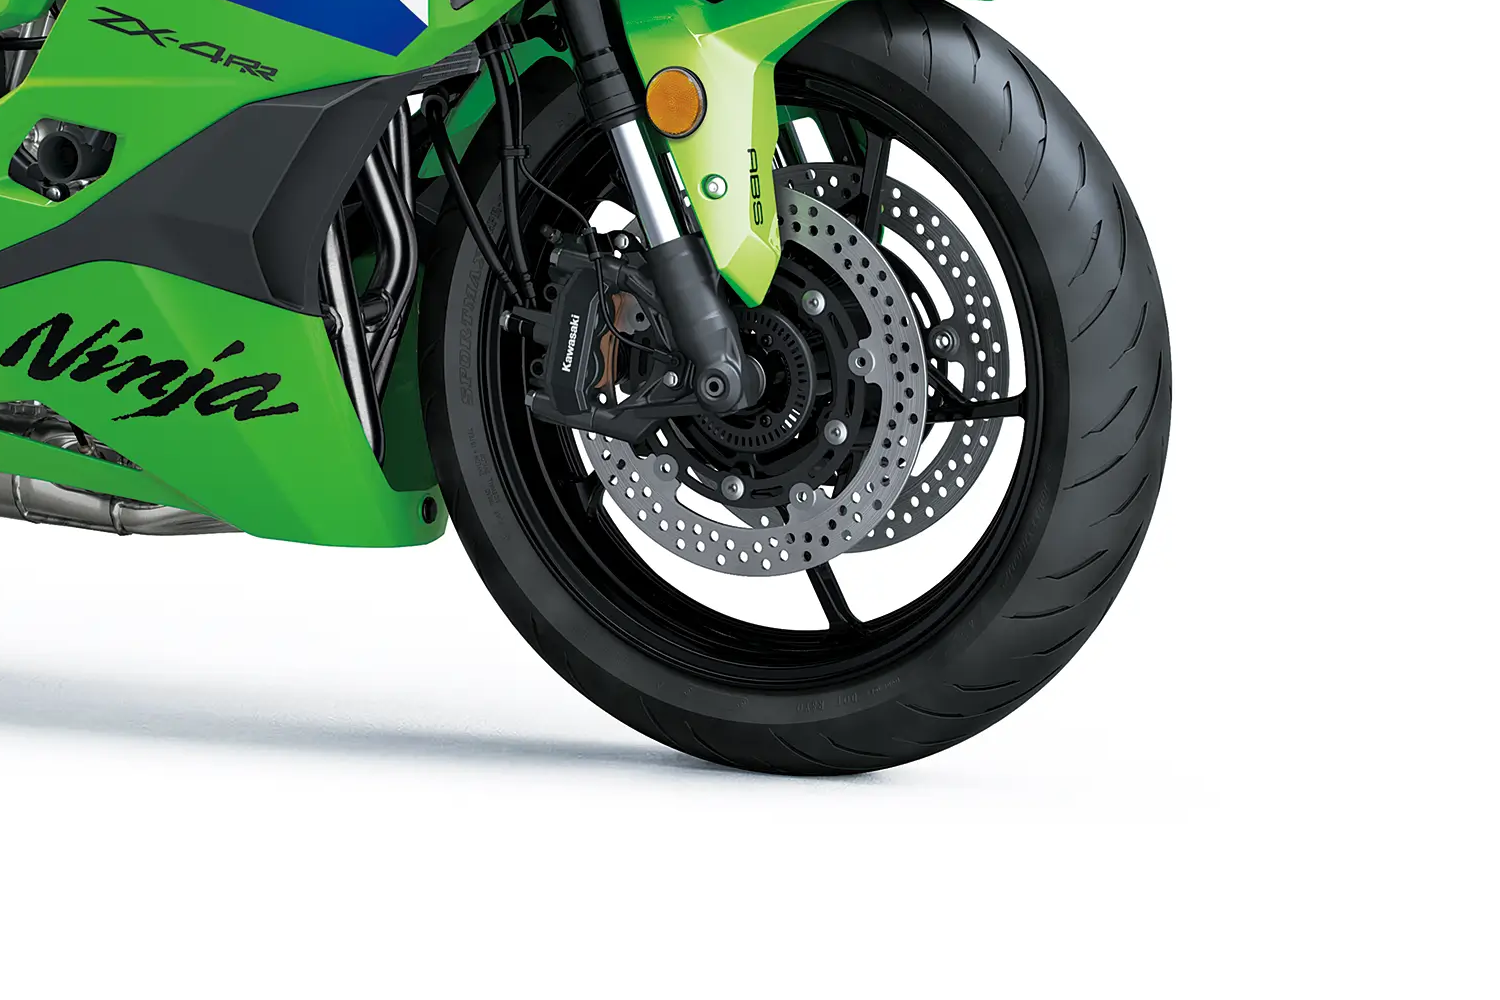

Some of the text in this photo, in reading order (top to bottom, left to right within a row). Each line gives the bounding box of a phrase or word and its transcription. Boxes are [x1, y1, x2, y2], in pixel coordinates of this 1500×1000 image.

[747, 148, 763, 225] ABS
[0, 312, 299, 421] Ninja
[562, 314, 580, 372] Kawasaki
